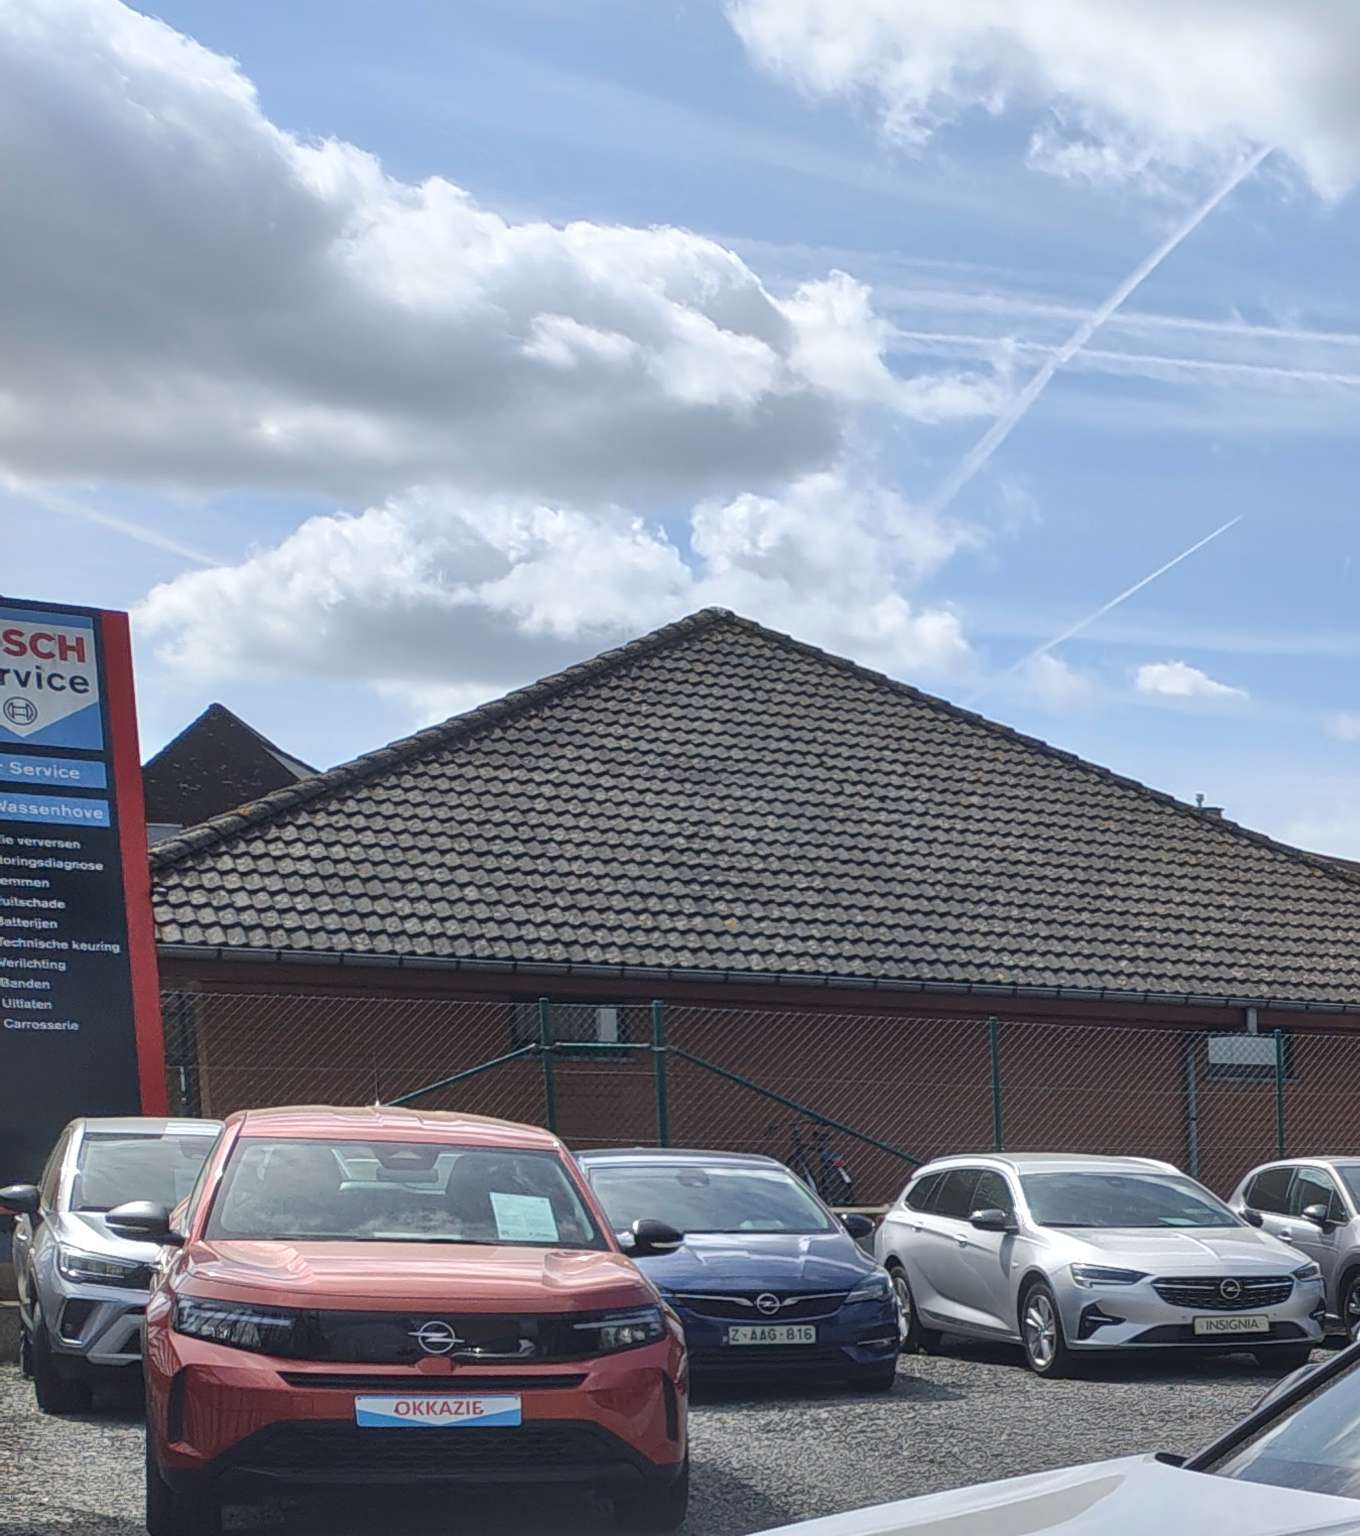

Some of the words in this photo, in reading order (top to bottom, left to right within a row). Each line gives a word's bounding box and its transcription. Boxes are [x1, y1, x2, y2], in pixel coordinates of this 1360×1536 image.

[0, 629, 86, 663] SCH
[9, 761, 81, 780] Service
[72, 939, 121, 954] keuring
[3, 1018, 80, 1031] Carrosserie
[1206, 1318, 1259, 1330] INSIGNIA
[394, 1401, 484, 1416] OKKAZIE
